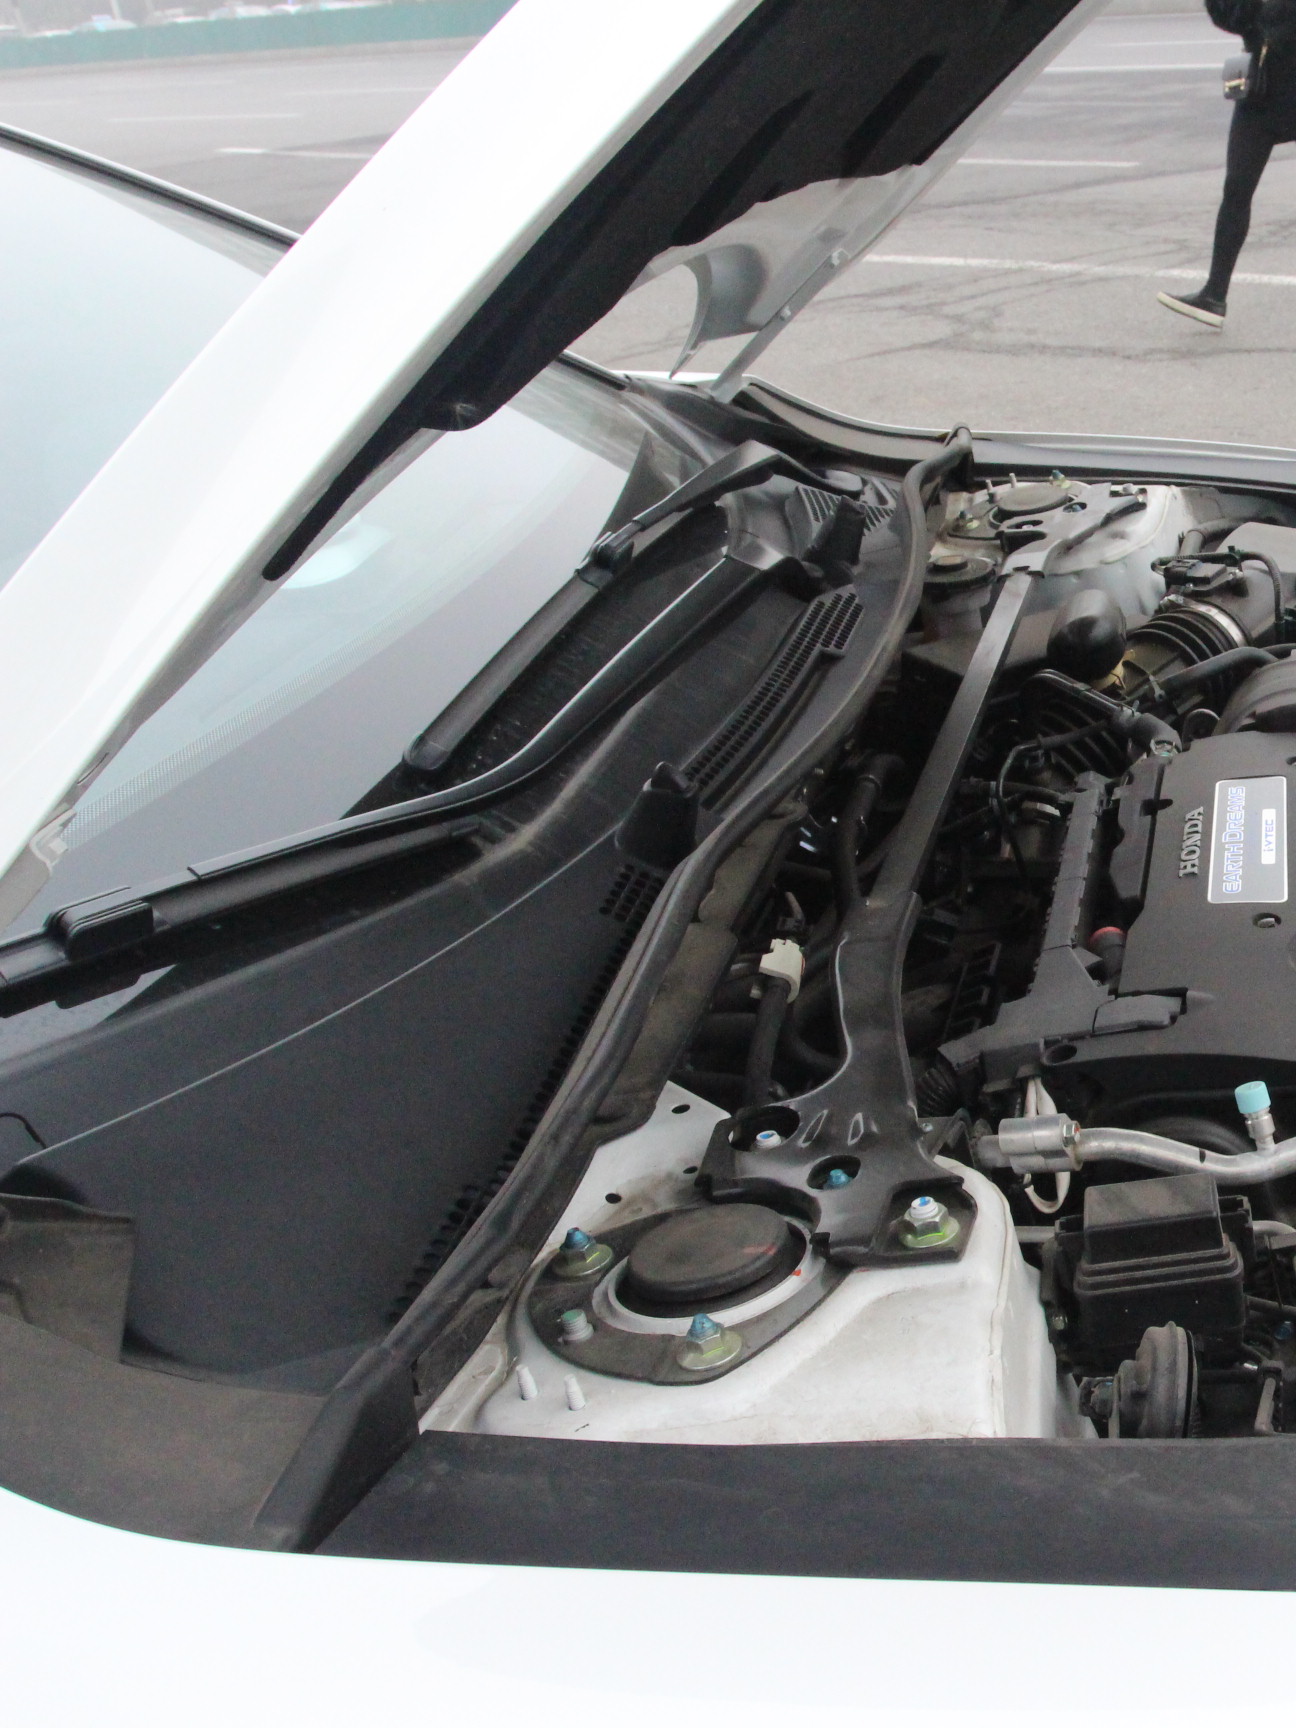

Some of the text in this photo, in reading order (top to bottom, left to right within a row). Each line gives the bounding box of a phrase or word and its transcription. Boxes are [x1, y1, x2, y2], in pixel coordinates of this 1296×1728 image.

[1179, 806, 1204, 878] HONDA
[1222, 786, 1246, 894] EARTH DREAMS
